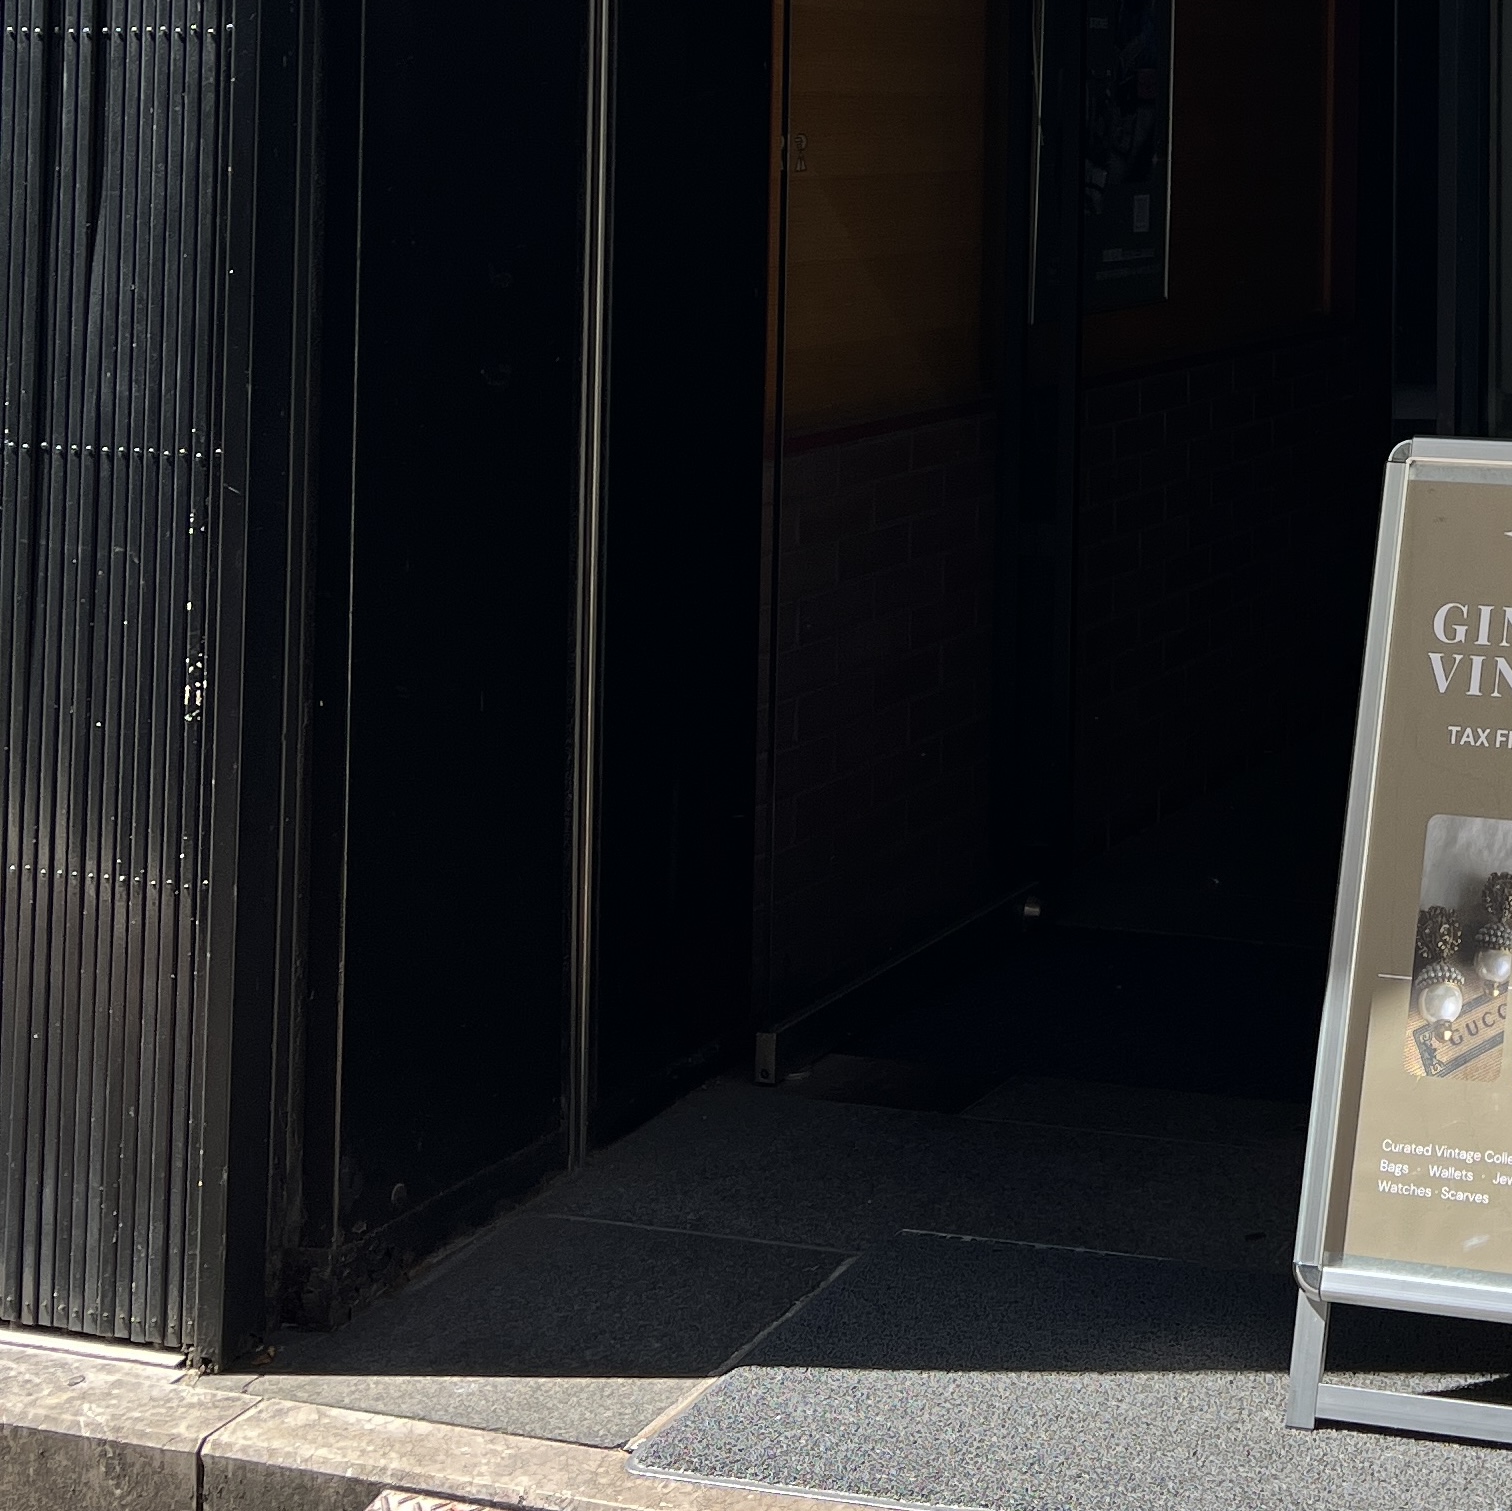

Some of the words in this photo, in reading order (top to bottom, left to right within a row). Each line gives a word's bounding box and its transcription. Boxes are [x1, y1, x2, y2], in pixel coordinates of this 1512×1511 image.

[1448, 725, 1489, 747] TAX
[1382, 1139, 1432, 1156] Curated
[1435, 1144, 1482, 1164] Vintage
[1379, 1159, 1409, 1176] Bags
[1428, 1164, 1474, 1182] Wallets
[1378, 1179, 1432, 1198] Watches
[1441, 1186, 1490, 1205] Scarves
